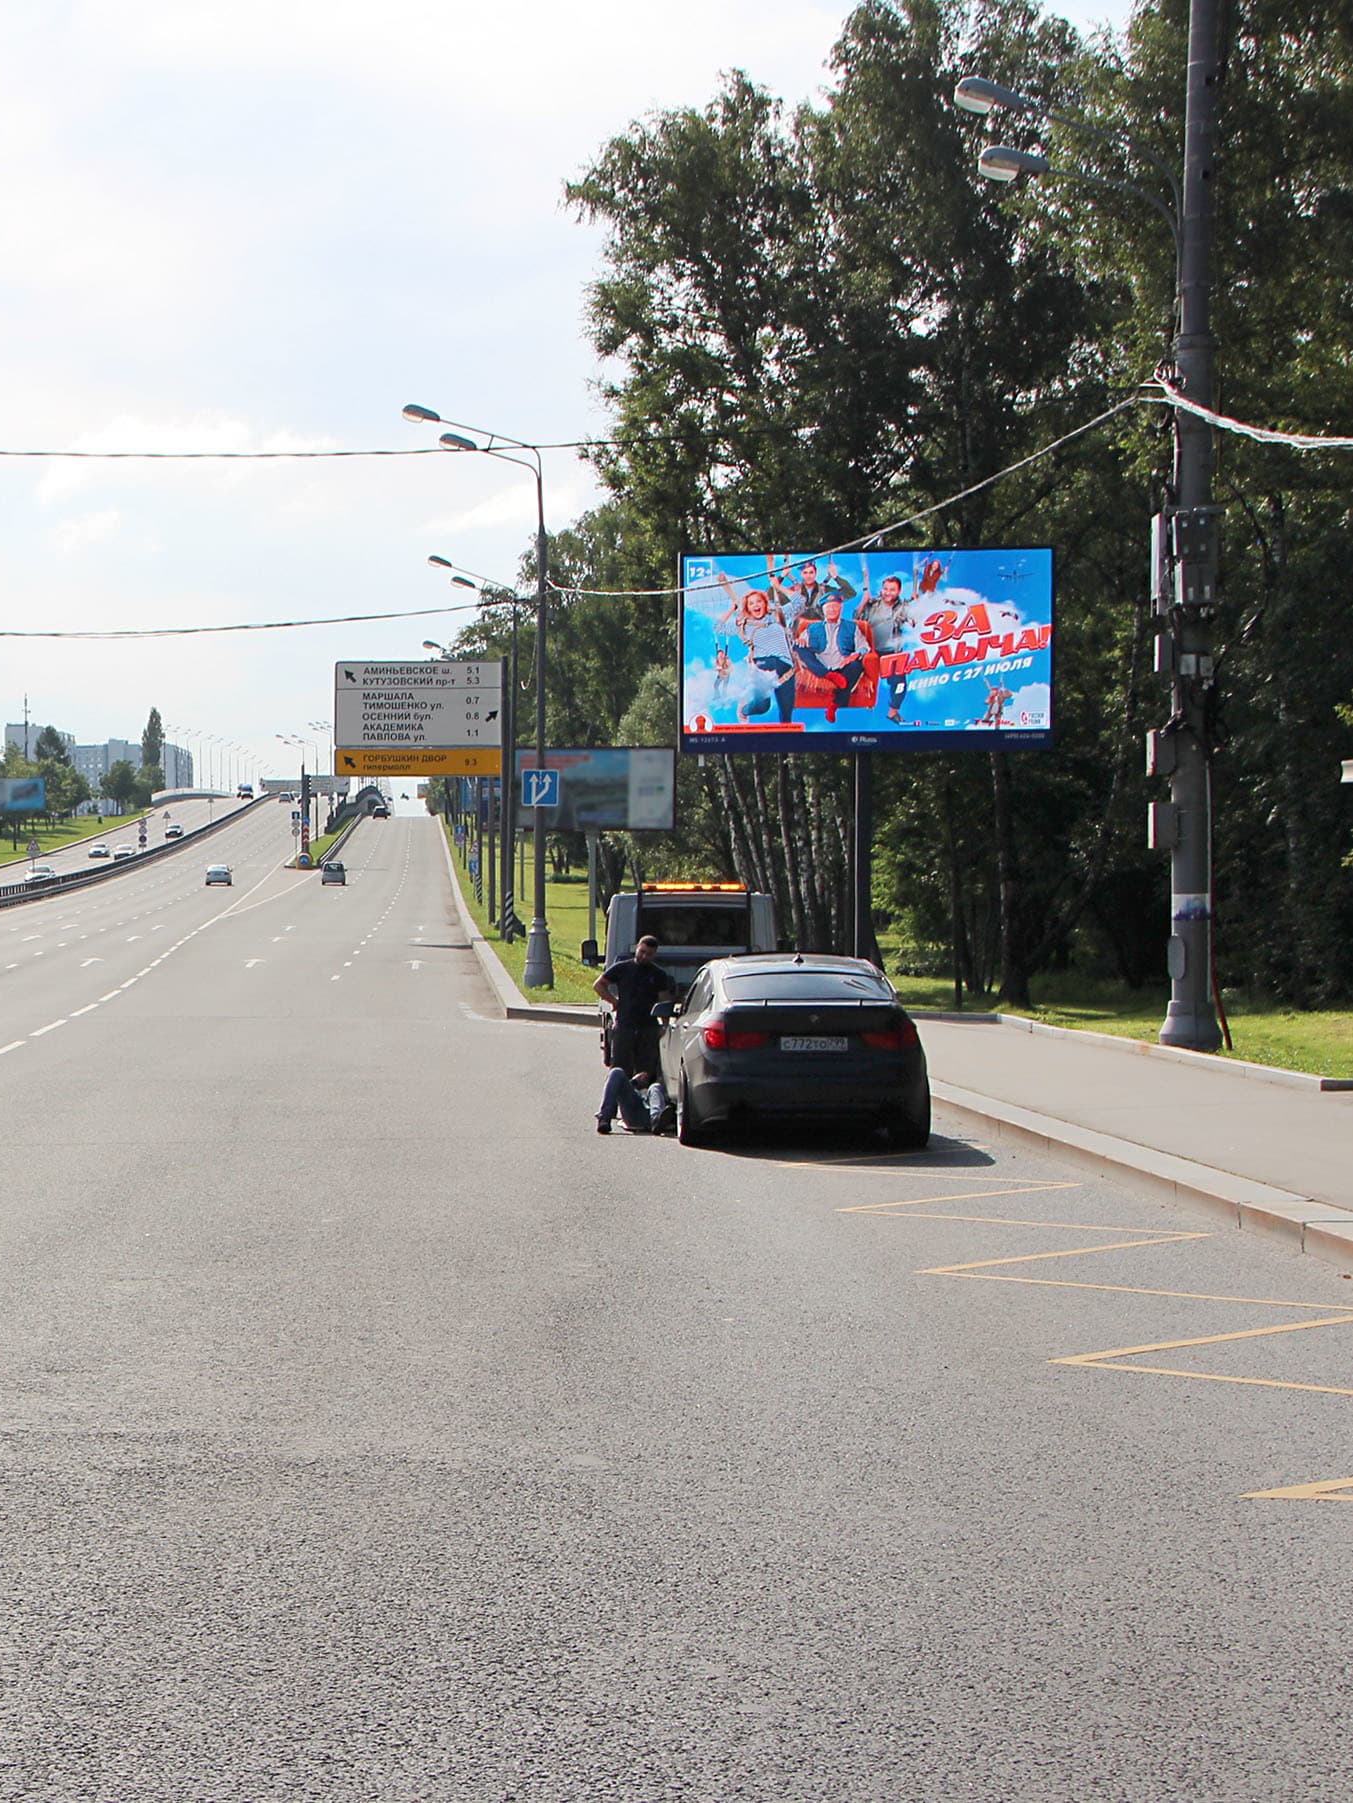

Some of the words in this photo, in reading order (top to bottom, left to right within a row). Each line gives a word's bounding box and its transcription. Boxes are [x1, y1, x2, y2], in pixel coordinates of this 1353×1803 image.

[689, 566, 712, 578] 12+
[920, 604, 993, 645] ЗА
[879, 624, 1054, 679] ПАЛЫЧА!
[363, 666, 439, 675] АМИНЬЕВСКОЕ
[466, 666, 480, 674] 5.1
[895, 683, 906, 694] В
[907, 674, 949, 690] КИНО
[952, 671, 962, 682] С
[963, 666, 981, 681] 27
[984, 656, 1033, 677] ИЮЛЯ
[362, 675, 433, 686] КУТУЗОВСКИЙ
[435, 678, 456, 687] пр-т
[466, 676, 480, 685] 5.3
[362, 692, 415, 701] МАРШАЛА
[465, 696, 480, 705] 0.7
[363, 702, 428, 710] ТИМОШЕНКО
[430, 703, 445, 711] ул.
[362, 711, 411, 721] ОСЕННИЙ
[413, 712, 433, 722] бул.
[465, 711, 480, 720] 0.8
[363, 723, 424, 732] АКАДЕМИКА
[363, 733, 411, 741] ПАВЛОВА
[466, 729, 479, 737] 1.1
[363, 754, 419, 762] ГОРБУШКИН
[422, 754, 447, 763] ДВОР
